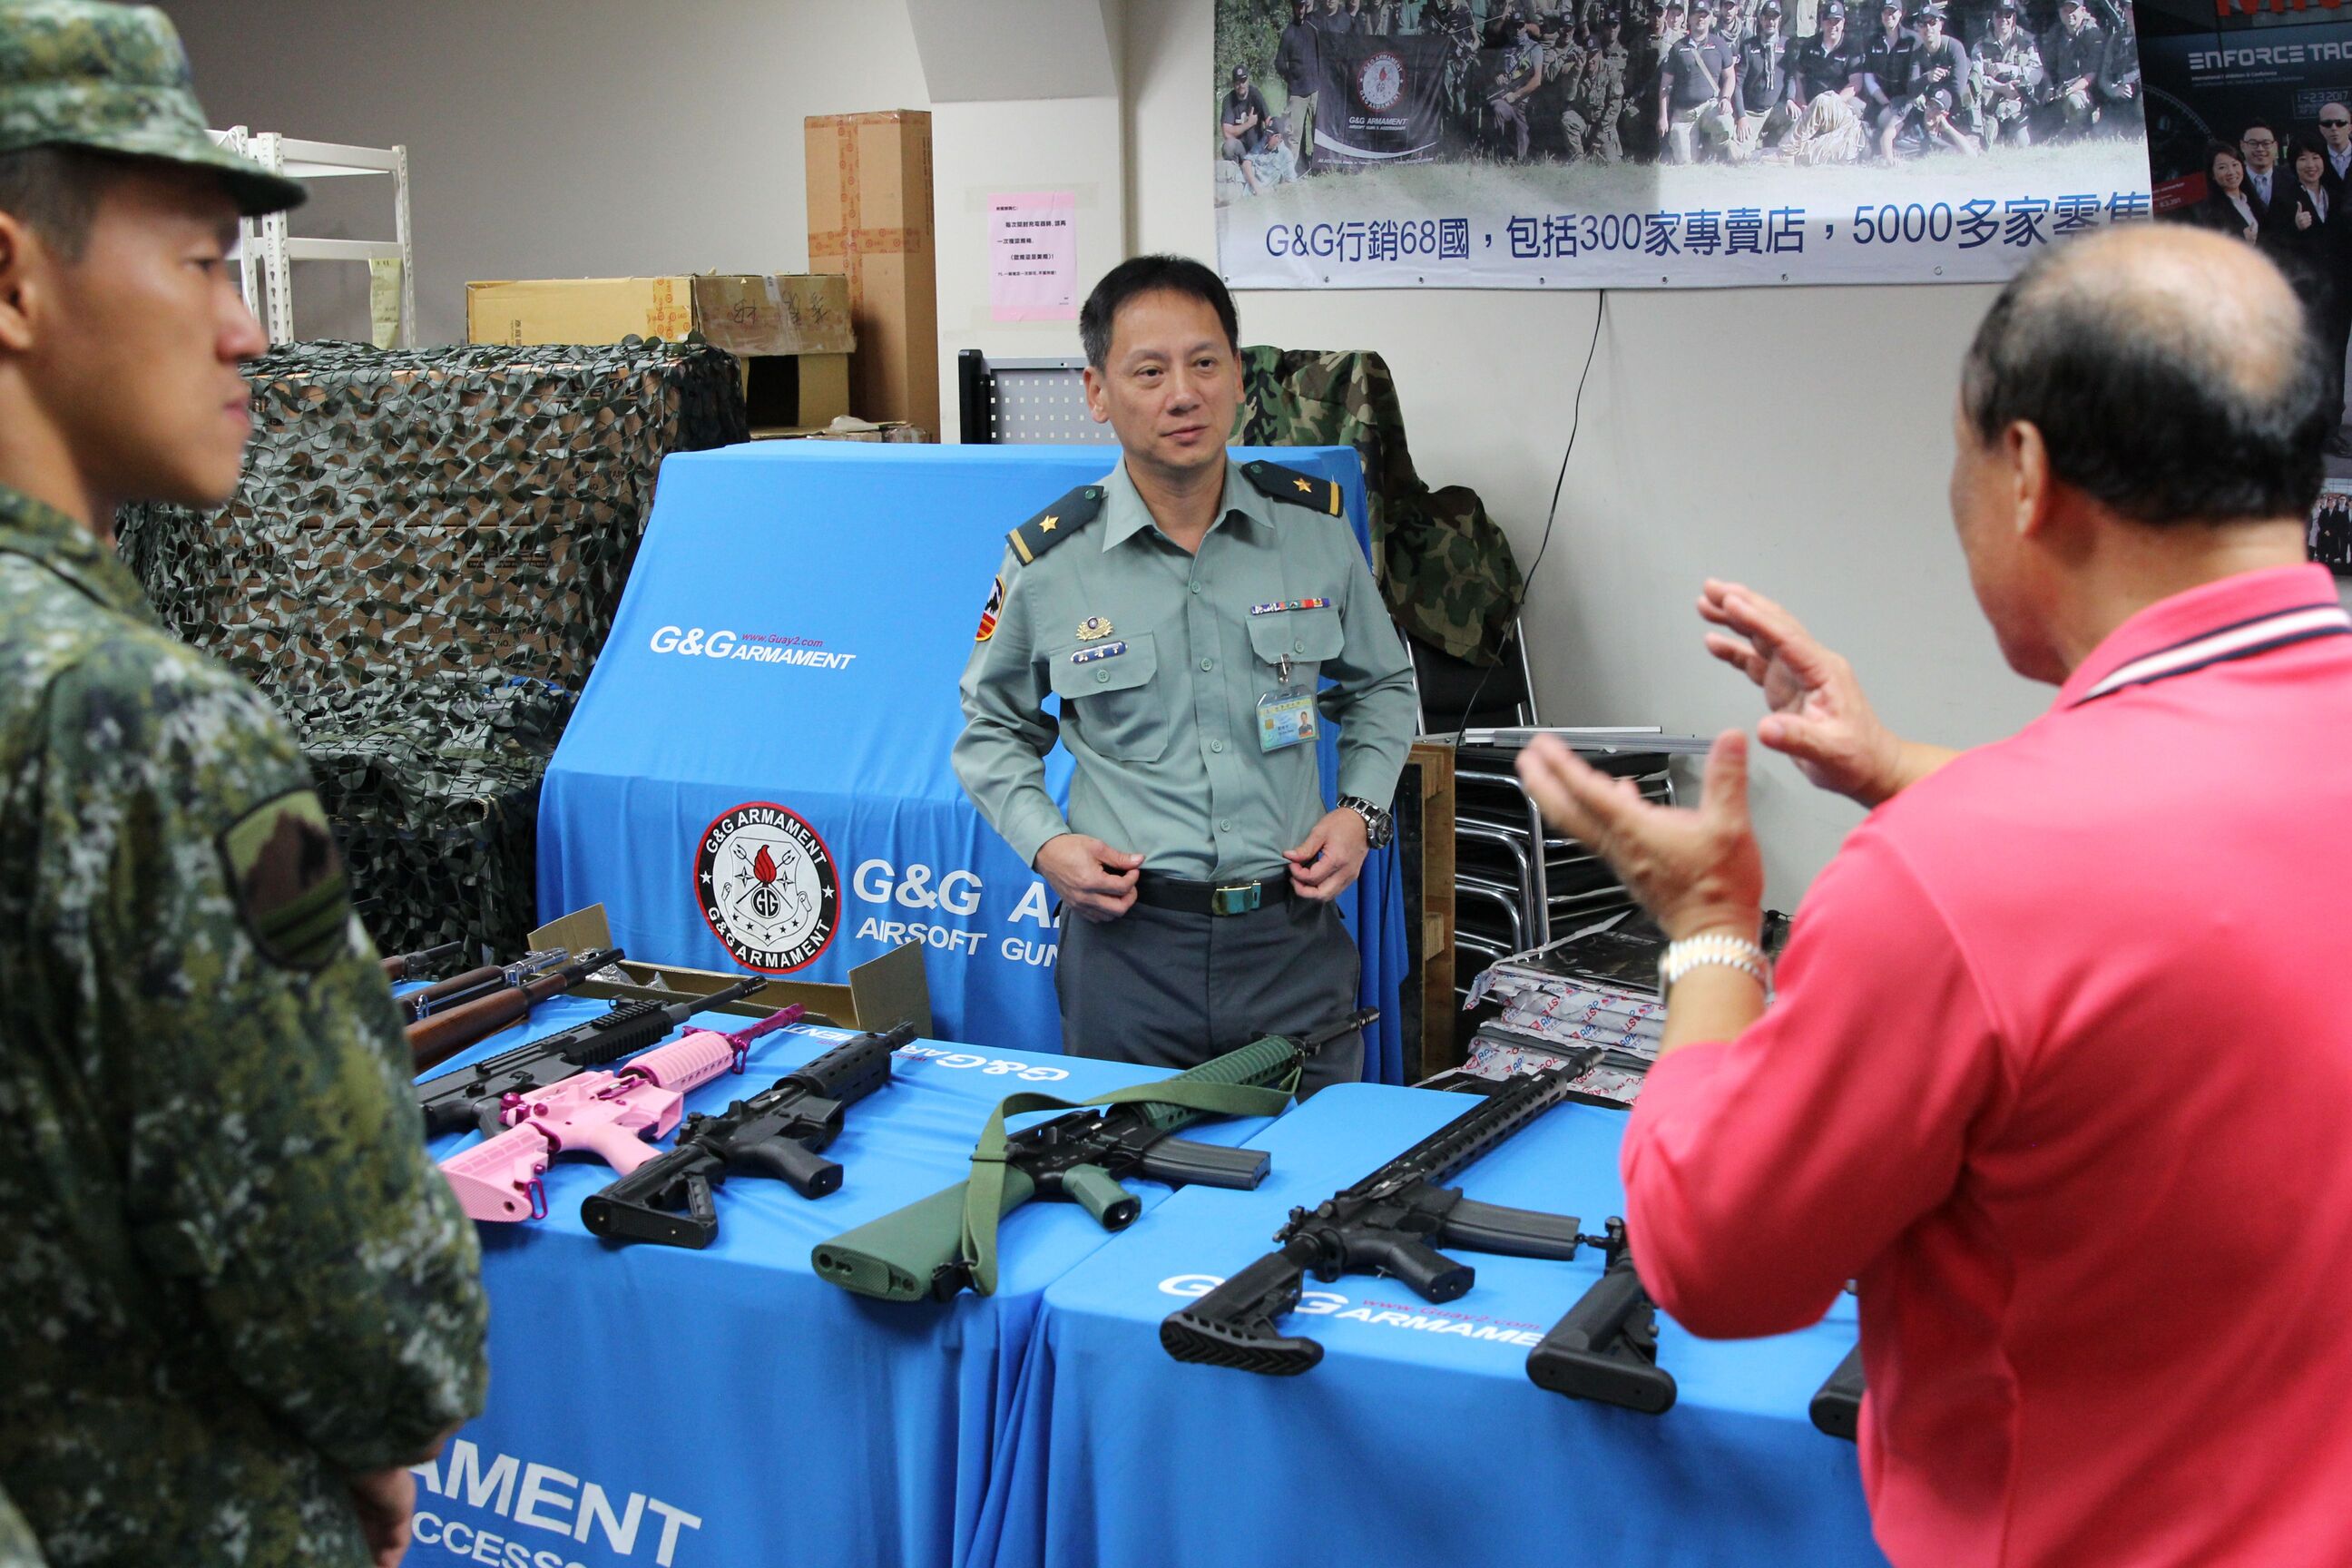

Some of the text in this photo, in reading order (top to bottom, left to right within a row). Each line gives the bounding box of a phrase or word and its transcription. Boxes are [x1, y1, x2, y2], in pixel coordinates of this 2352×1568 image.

[2188, 45, 2305, 70] ENFORCE
[1348, 116, 1365, 124] G&G
[650, 625, 857, 670] G&G ARMAMENT
[741, 632, 823, 648] www.Guay2.com
[706, 808, 827, 865] G&G ARMAMENT
[852, 858, 1061, 929] G&G A
[708, 906, 830, 968] G&G ARMAMENT
[856, 916, 987, 956] AIRSOFT
[936, 1054, 1070, 1082] G&G
[1333, 1308, 1545, 1348] ARMAME
[409, 1438, 702, 1568] AMENT
[411, 1511, 588, 1568] CCESS
